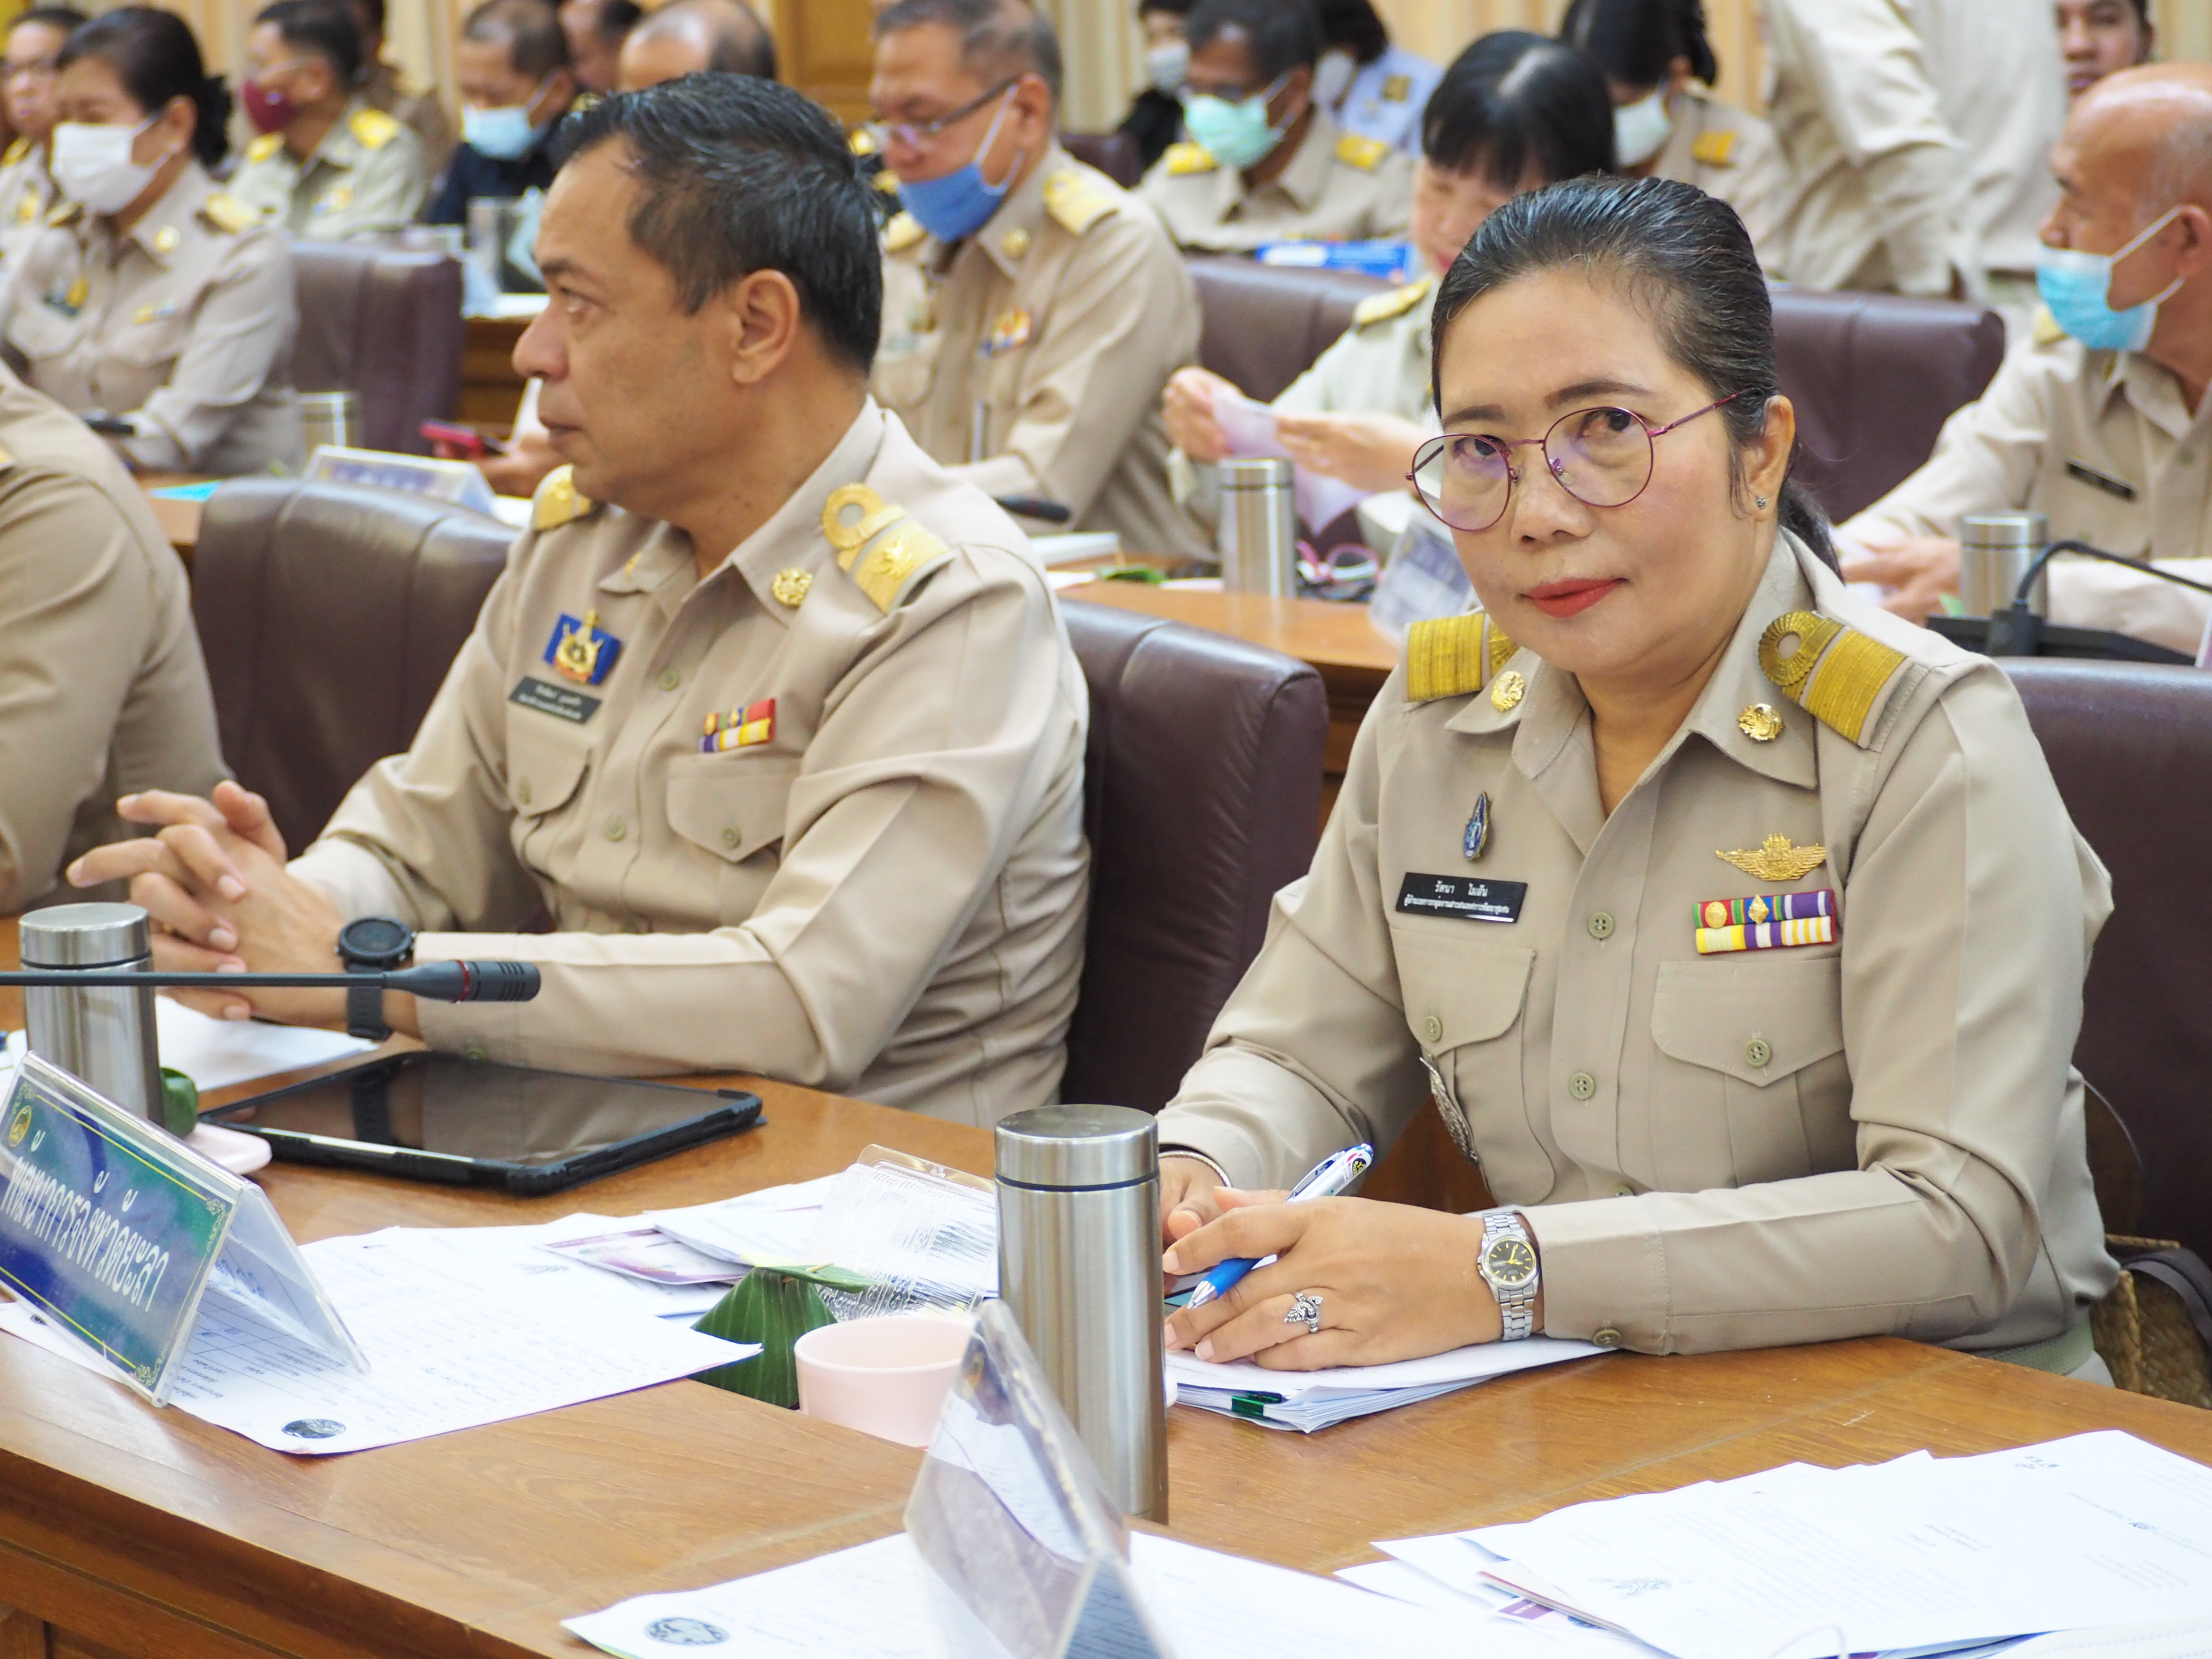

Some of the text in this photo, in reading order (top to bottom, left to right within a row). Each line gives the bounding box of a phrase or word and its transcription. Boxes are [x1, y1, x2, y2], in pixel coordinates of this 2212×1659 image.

[0, 1130, 170, 1313] พัฒนาการจังหวัดยะลา
